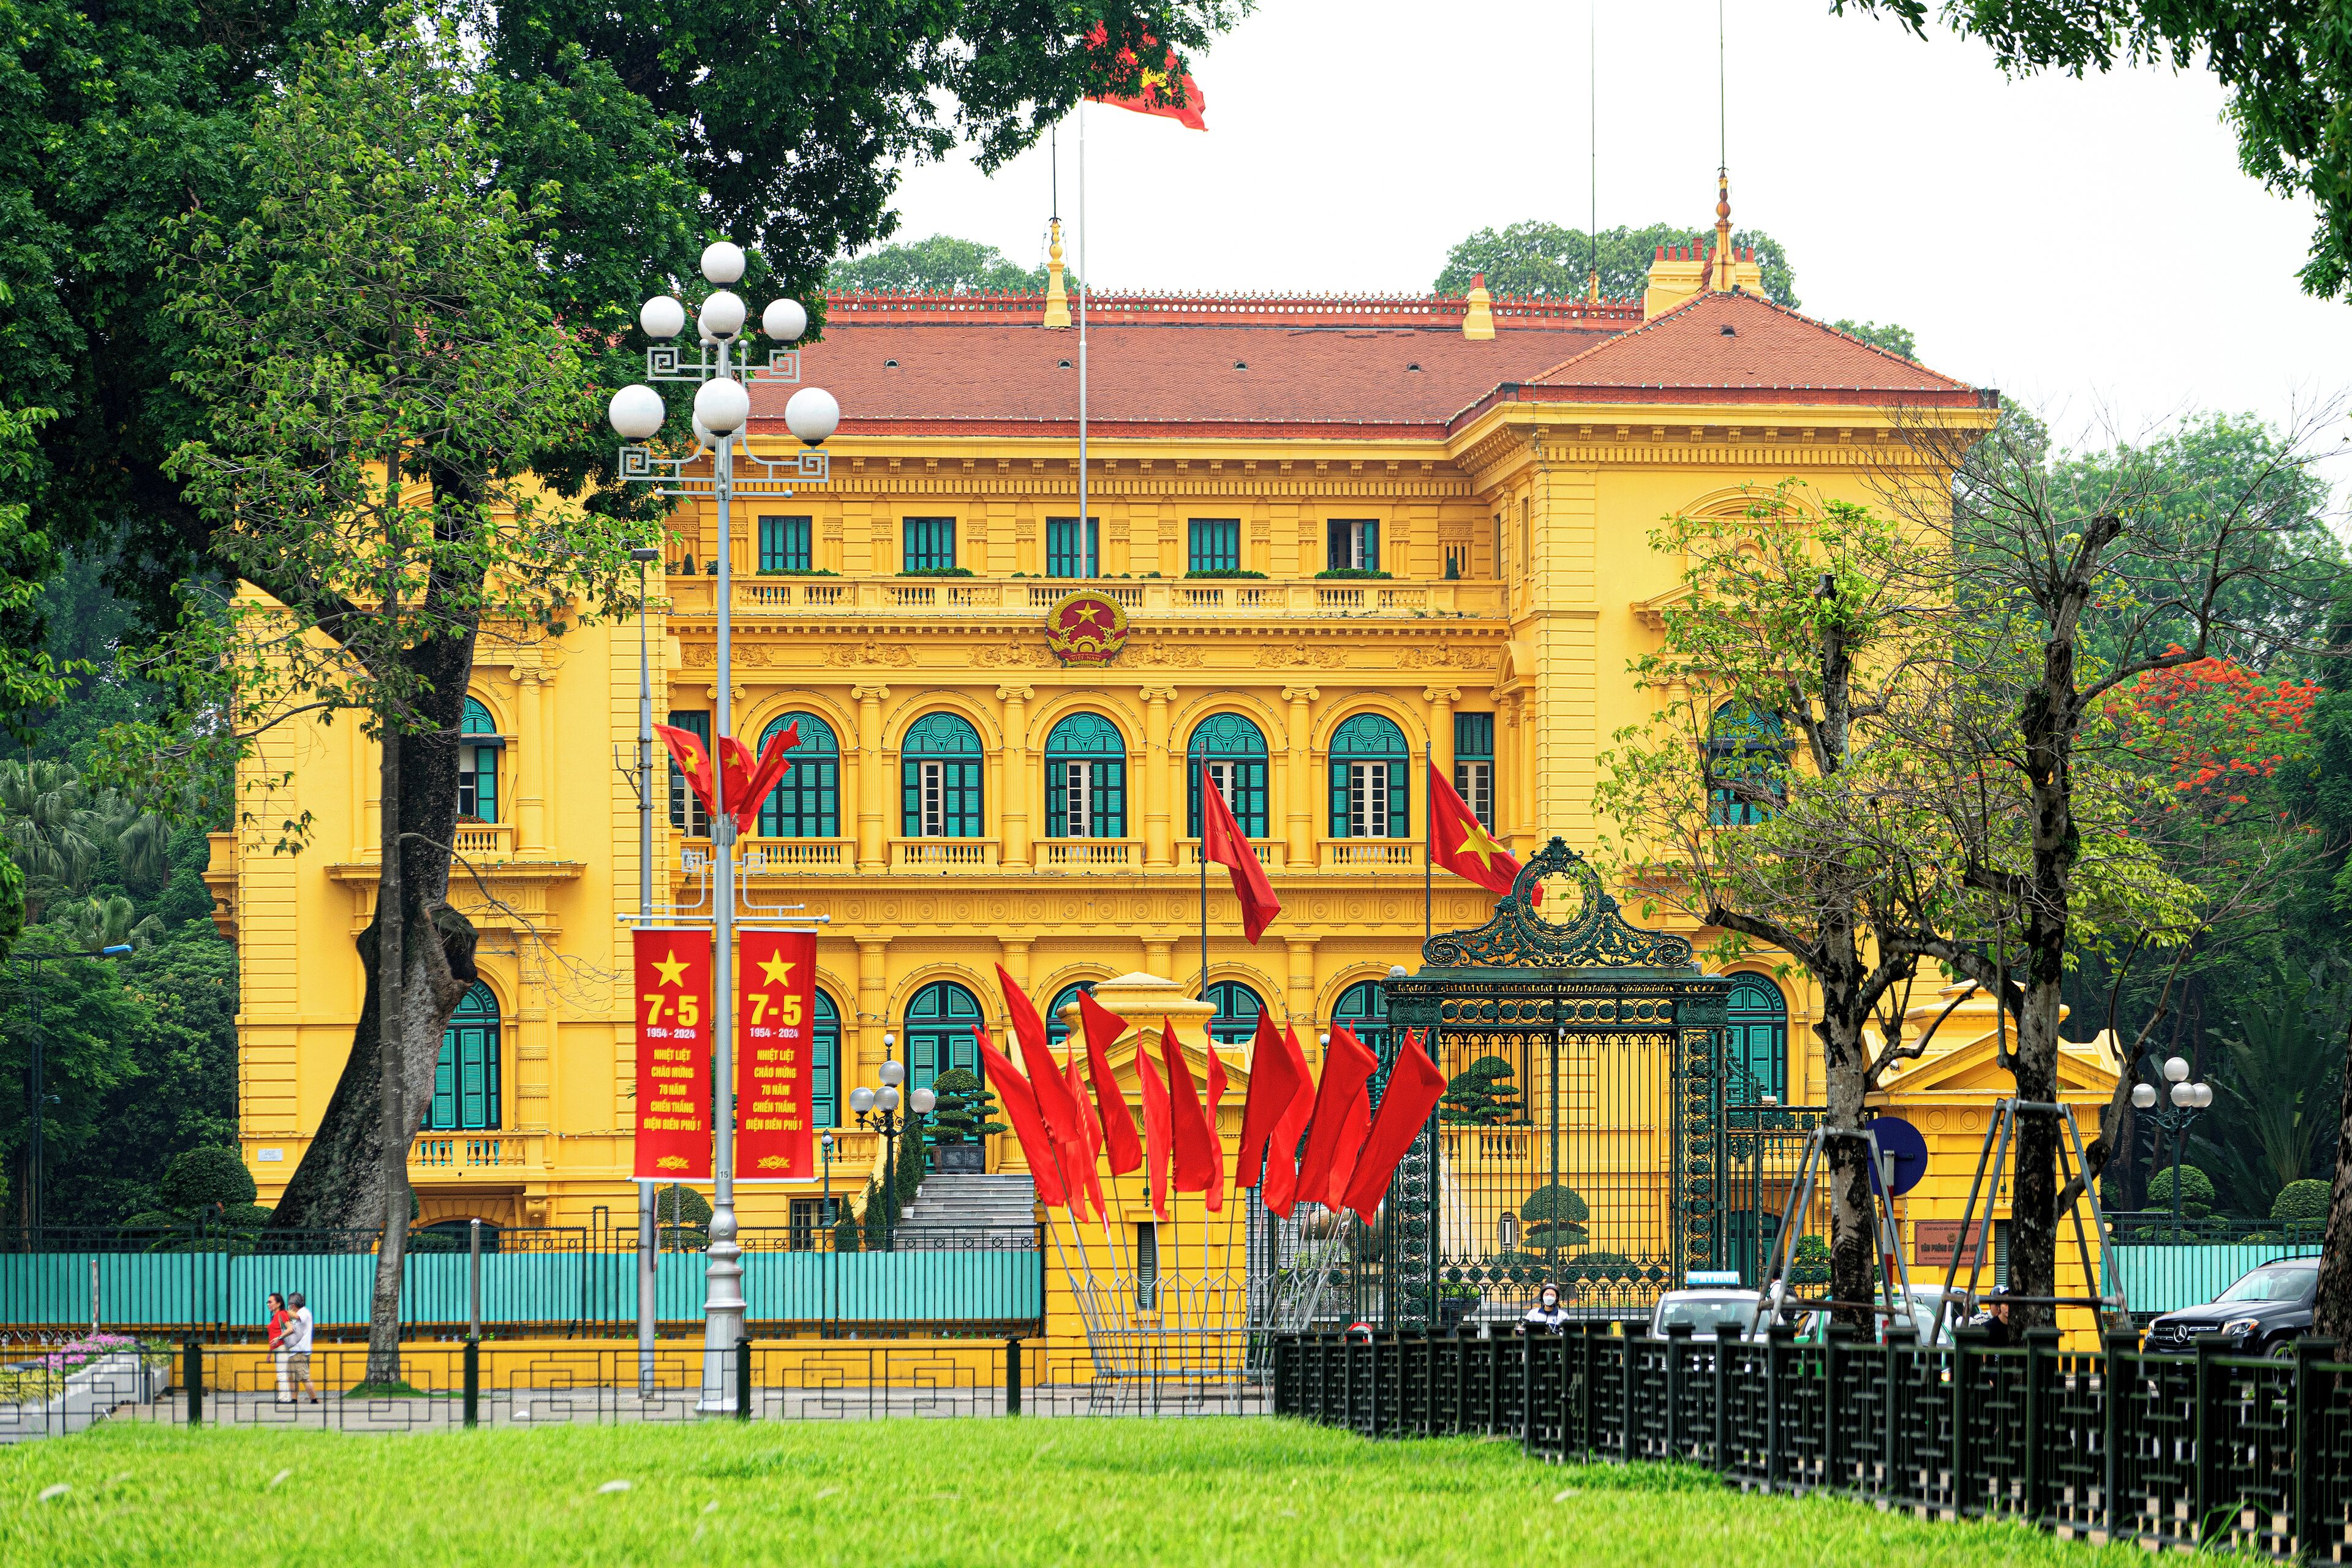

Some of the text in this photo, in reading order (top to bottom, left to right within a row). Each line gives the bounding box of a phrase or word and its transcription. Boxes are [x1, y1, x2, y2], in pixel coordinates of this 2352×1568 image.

[646, 1028, 668, 1038] 1954
[674, 1028, 696, 1039] 2024
[750, 1027, 771, 1038] 1954
[778, 1028, 799, 1038] 2024
[654, 1047, 691, 1063] NHIỆT LIỆT
[756, 1048, 795, 1063] NHIỆT LIỆT
[651, 1065, 694, 1079] CHÀO MỪNG
[754, 1065, 797, 1079] CHÀO MỪNG
[658, 1082, 687, 1096] 70 NĂM
[761, 1082, 790, 1096] 70 NĂM
[650, 1098, 694, 1114] CHIẾN THẮNG
[753, 1099, 796, 1114] CHIẾN THẮNG
[643, 1116, 662, 1131] ĐIỆN
[662, 1117, 679, 1131] BIÊN
[680, 1116, 696, 1131] PHỦ
[745, 1117, 764, 1133] ĐIỆN
[764, 1117, 782, 1131] BIÊN
[783, 1116, 798, 1131] PHỦ
